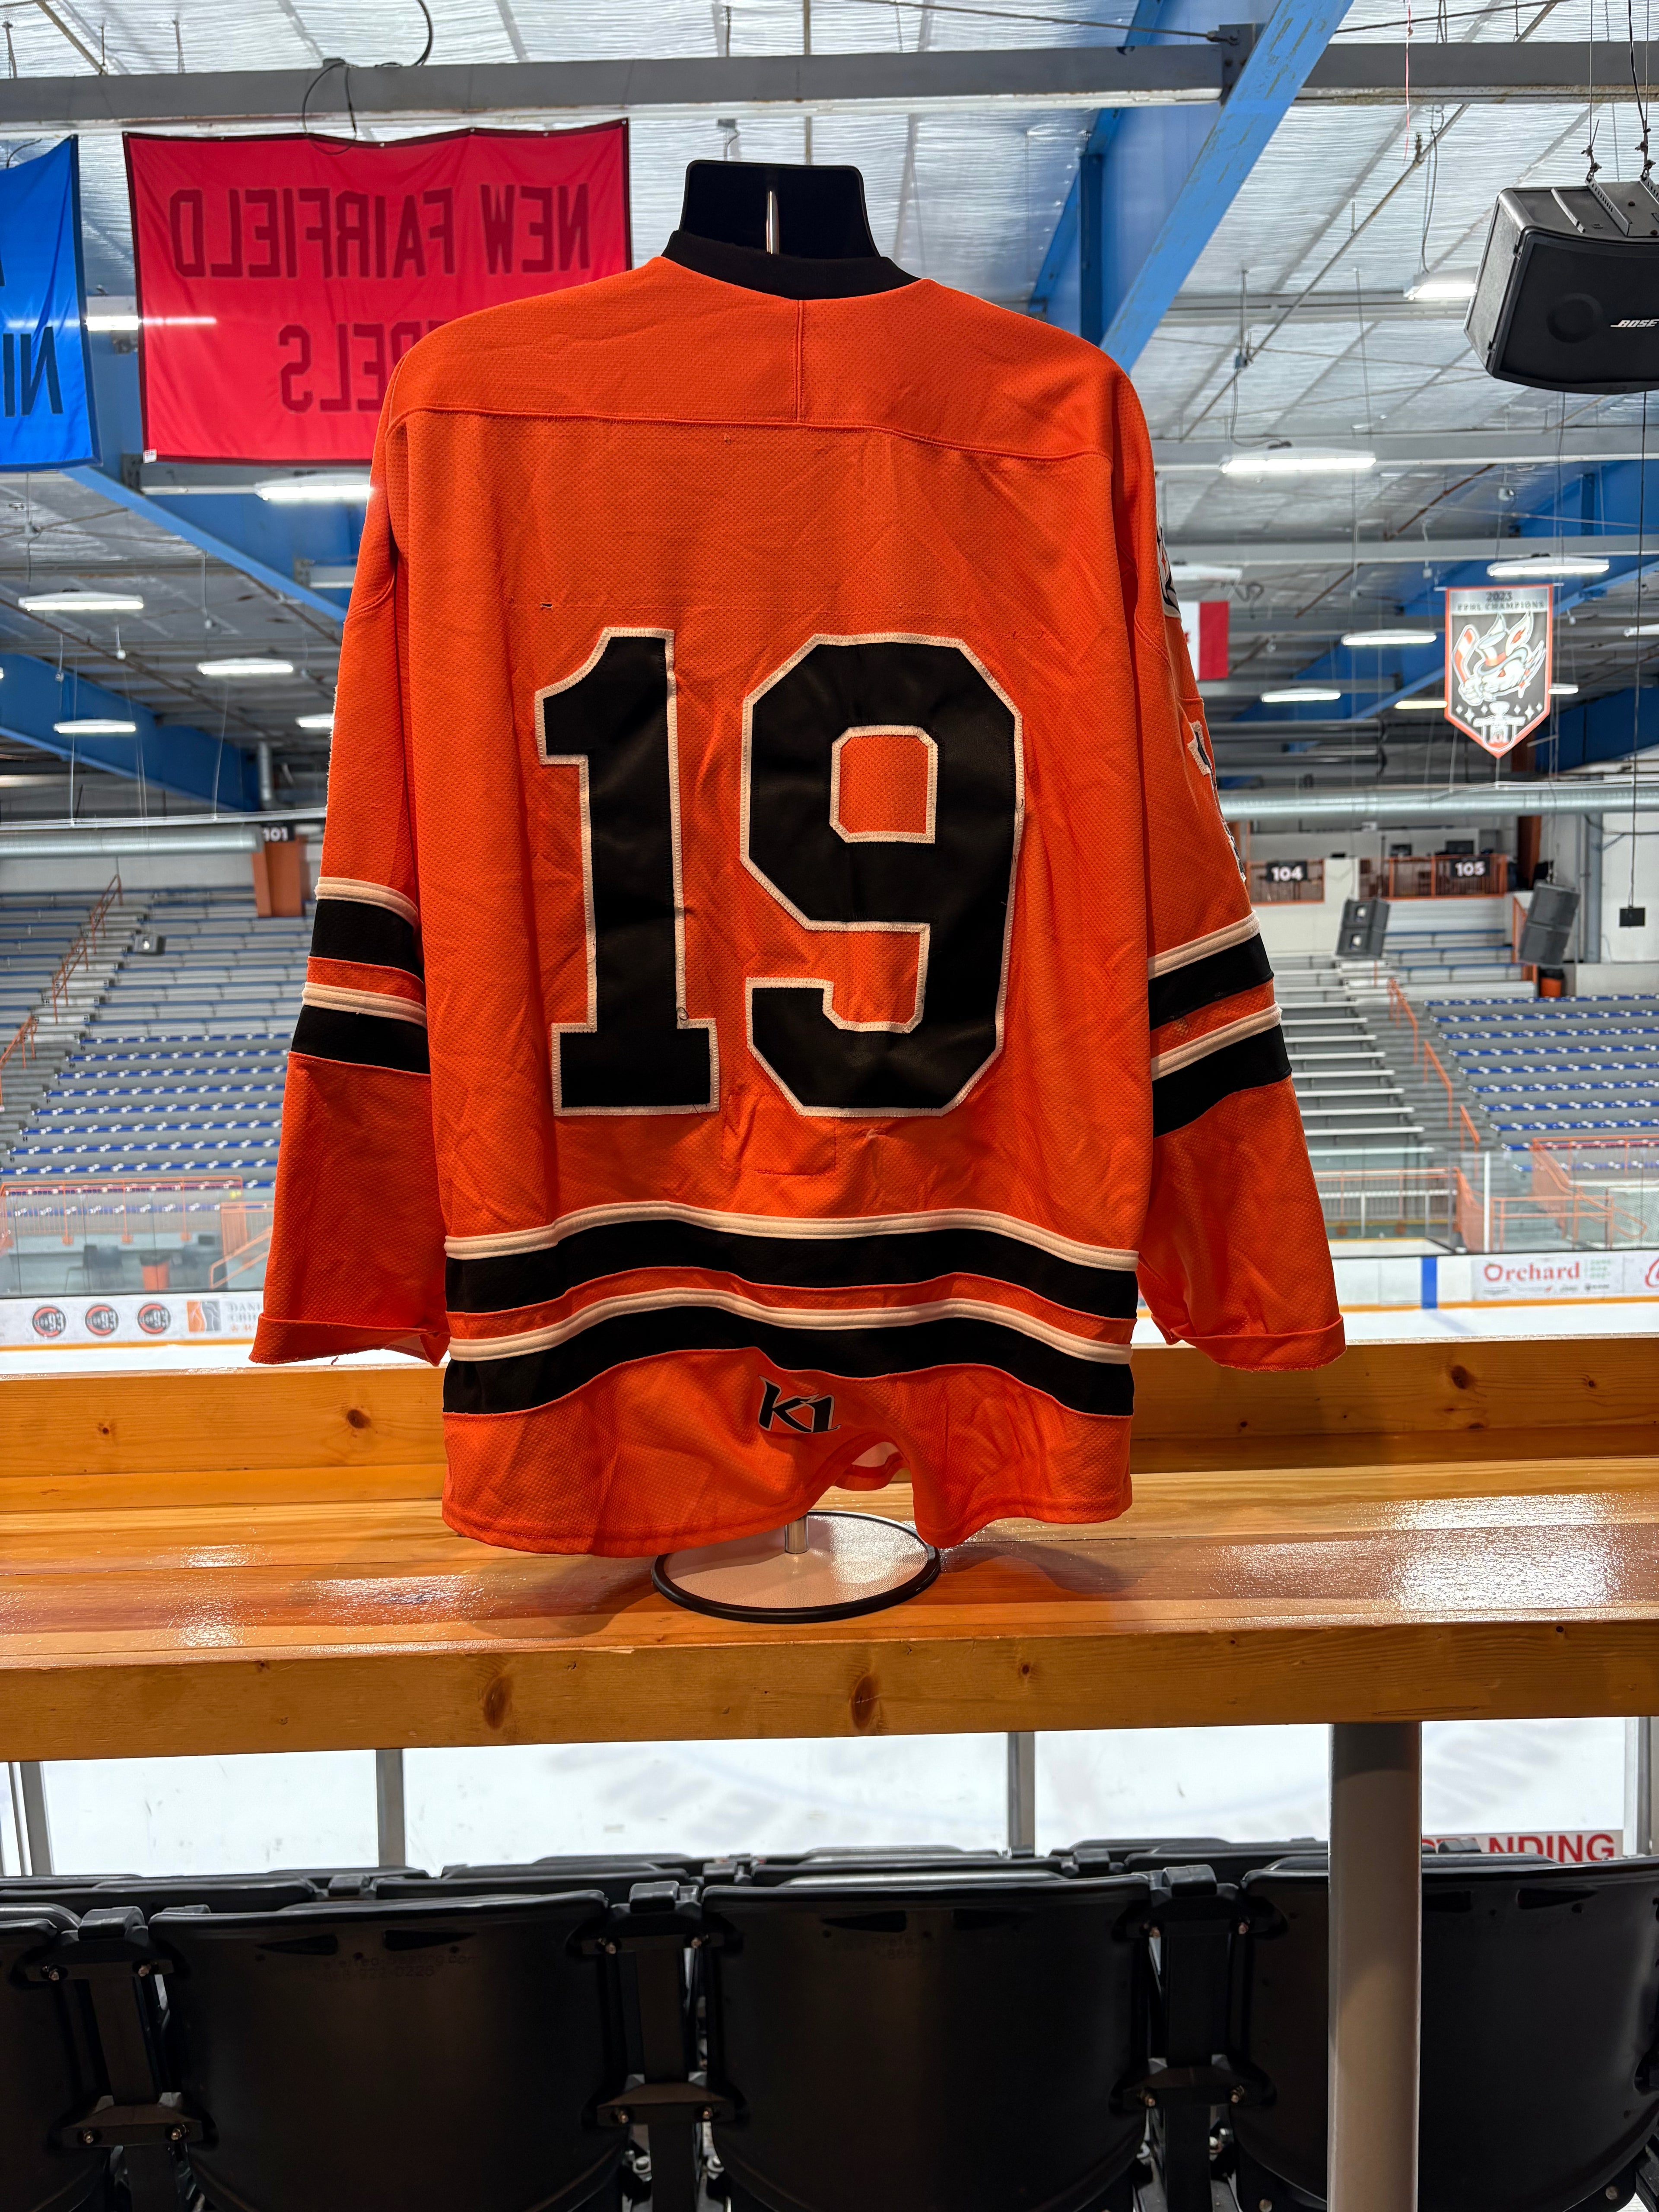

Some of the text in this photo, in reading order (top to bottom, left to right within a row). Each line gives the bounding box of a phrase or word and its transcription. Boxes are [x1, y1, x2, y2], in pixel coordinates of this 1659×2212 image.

[1610, 319, 1659, 327] BOSE
[1486, 591, 1513, 602] 2023
[1485, 601, 1545, 610] CHAMPIONS
[263, 826, 288, 842] 101
[535, 627, 1024, 1117] 19
[1271, 866, 1303, 882] 104
[1454, 861, 1485, 877] 105
[1484, 1261, 1580, 1282] Orchard
